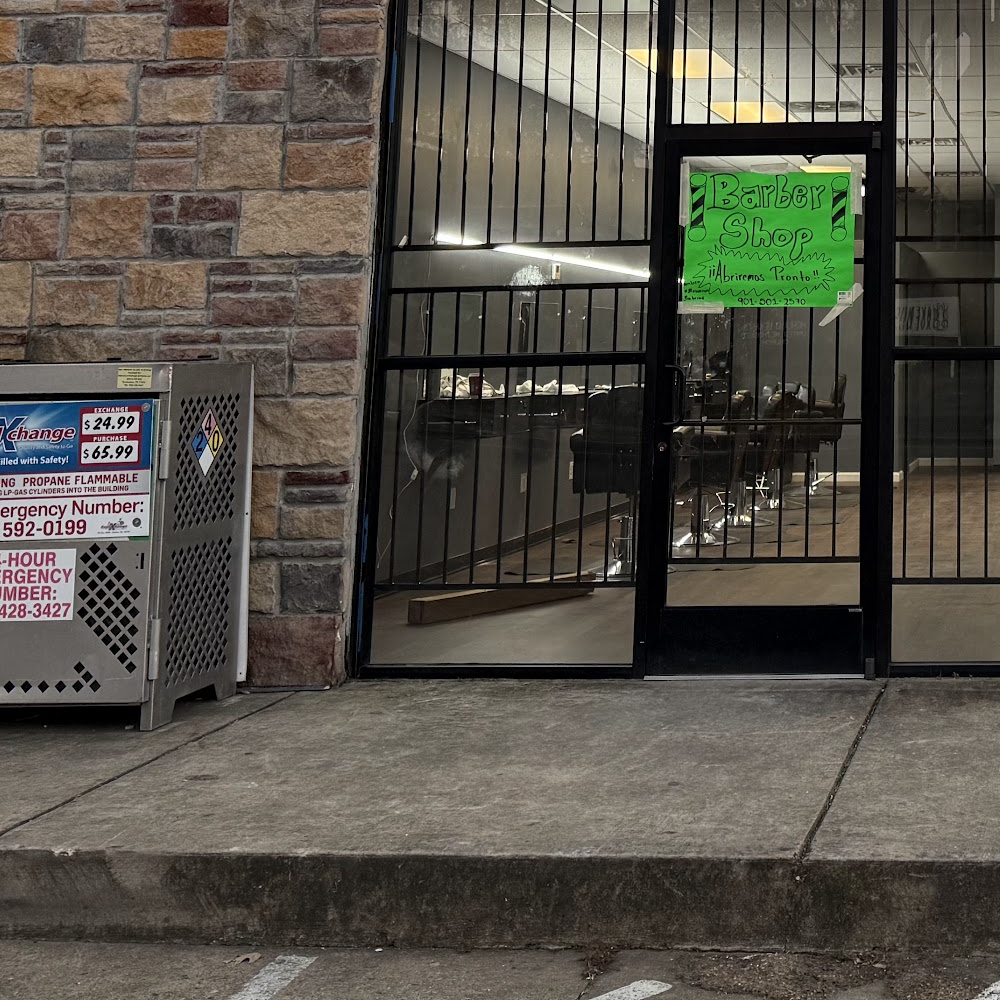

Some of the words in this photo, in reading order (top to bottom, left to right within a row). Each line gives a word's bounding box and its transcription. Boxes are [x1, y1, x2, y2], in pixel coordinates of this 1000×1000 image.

[706, 172, 826, 211] Barber
[719, 212, 813, 261] Shop
[204, 413, 212, 436] 4
[195, 430, 204, 452] 2
[212, 430, 220, 452] 0
[20, 456, 39, 465] with
[40, 455, 69, 466] Safety!
[23, 475, 71, 487] PROPANE
[74, 472, 138, 485] FLAMMABLE
[28, 486, 66, 495] CYLINDERS
[66, 485, 82, 494] INTO
[84, 485, 96, 493] THE
[98, 484, 129, 493] BUILDING
[0, 504, 68, 521] ergency
[72, 498, 144, 516] Number:
[2, 519, 87, 538] 592-0199
[0, 568, 73, 585] RGENCY
[0, 585, 57, 602] MBER:
